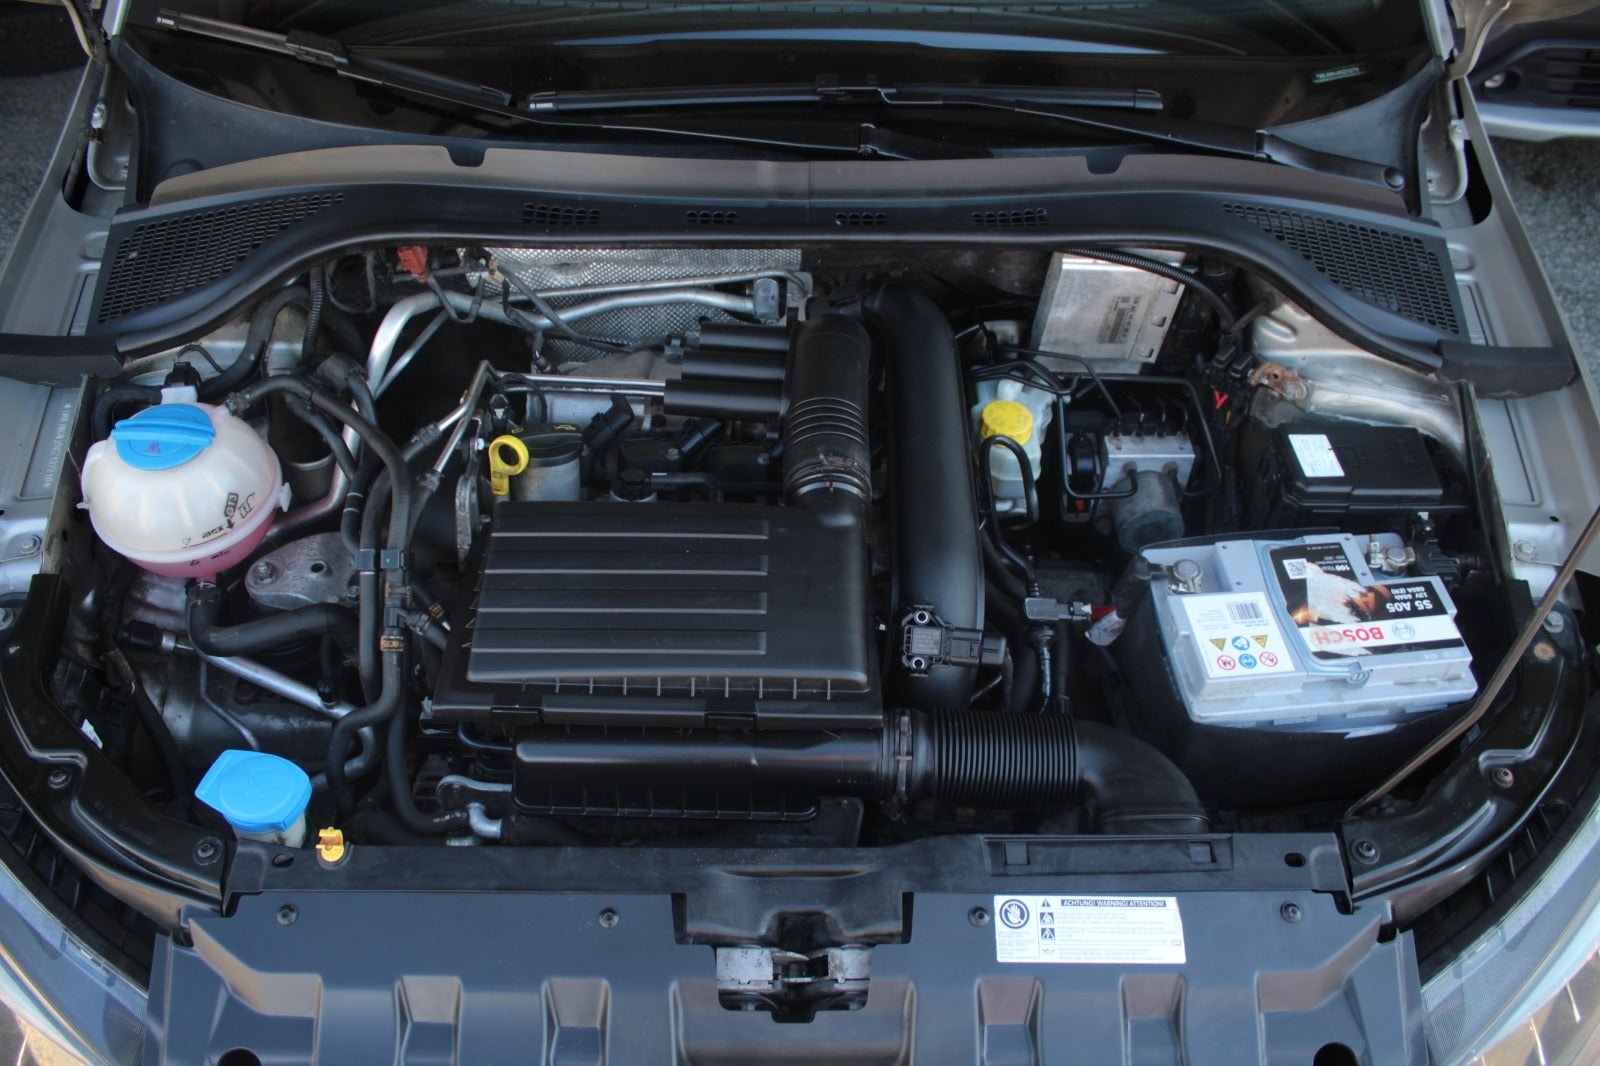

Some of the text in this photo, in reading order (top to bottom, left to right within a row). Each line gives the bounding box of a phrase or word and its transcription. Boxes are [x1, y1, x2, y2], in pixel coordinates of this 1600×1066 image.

[1385, 599, 1433, 613] S5 A05
[1314, 626, 1385, 646] BOSCH
